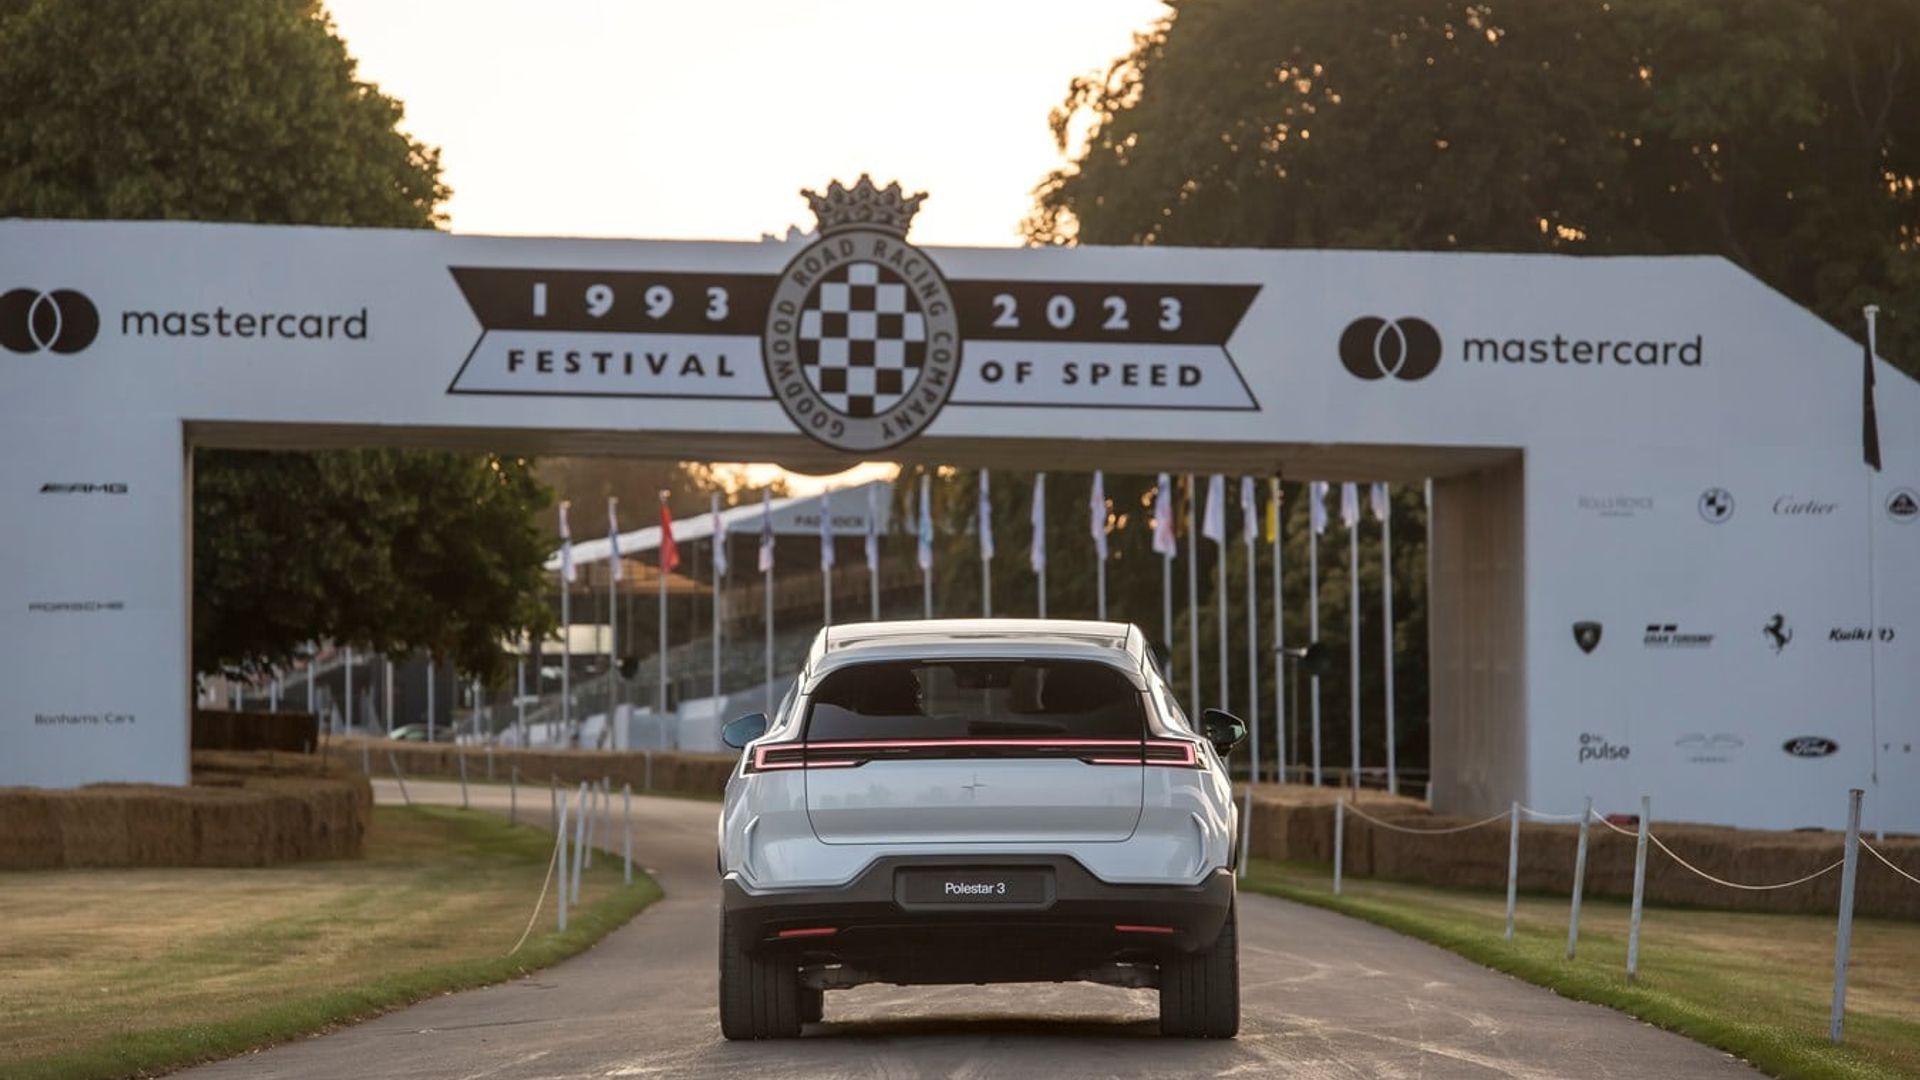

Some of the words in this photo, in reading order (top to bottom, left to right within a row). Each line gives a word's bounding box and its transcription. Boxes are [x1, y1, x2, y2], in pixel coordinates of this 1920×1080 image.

[792, 239, 854, 287] ROAD
[873, 239, 948, 317] RACING
[121, 307, 368, 339] mastercard
[533, 283, 730, 320] 1993
[992, 294, 1183, 331] 2023
[1463, 334, 1703, 366] mastercard
[508, 350, 735, 377] FESTIVAL
[980, 361, 1033, 384] OF
[1062, 362, 1203, 387] SPEED
[773, 300, 846, 439] GOODWOOD
[880, 332, 953, 440] COMPANY
[794, 515, 864, 527] PADOCK
[1772, 496, 1838, 515] Cartier
[1829, 628, 1865, 641] Kwik
[1579, 742, 1630, 764] pulse
[945, 882, 995, 894] Polestar
[997, 882, 1006, 894] 3
